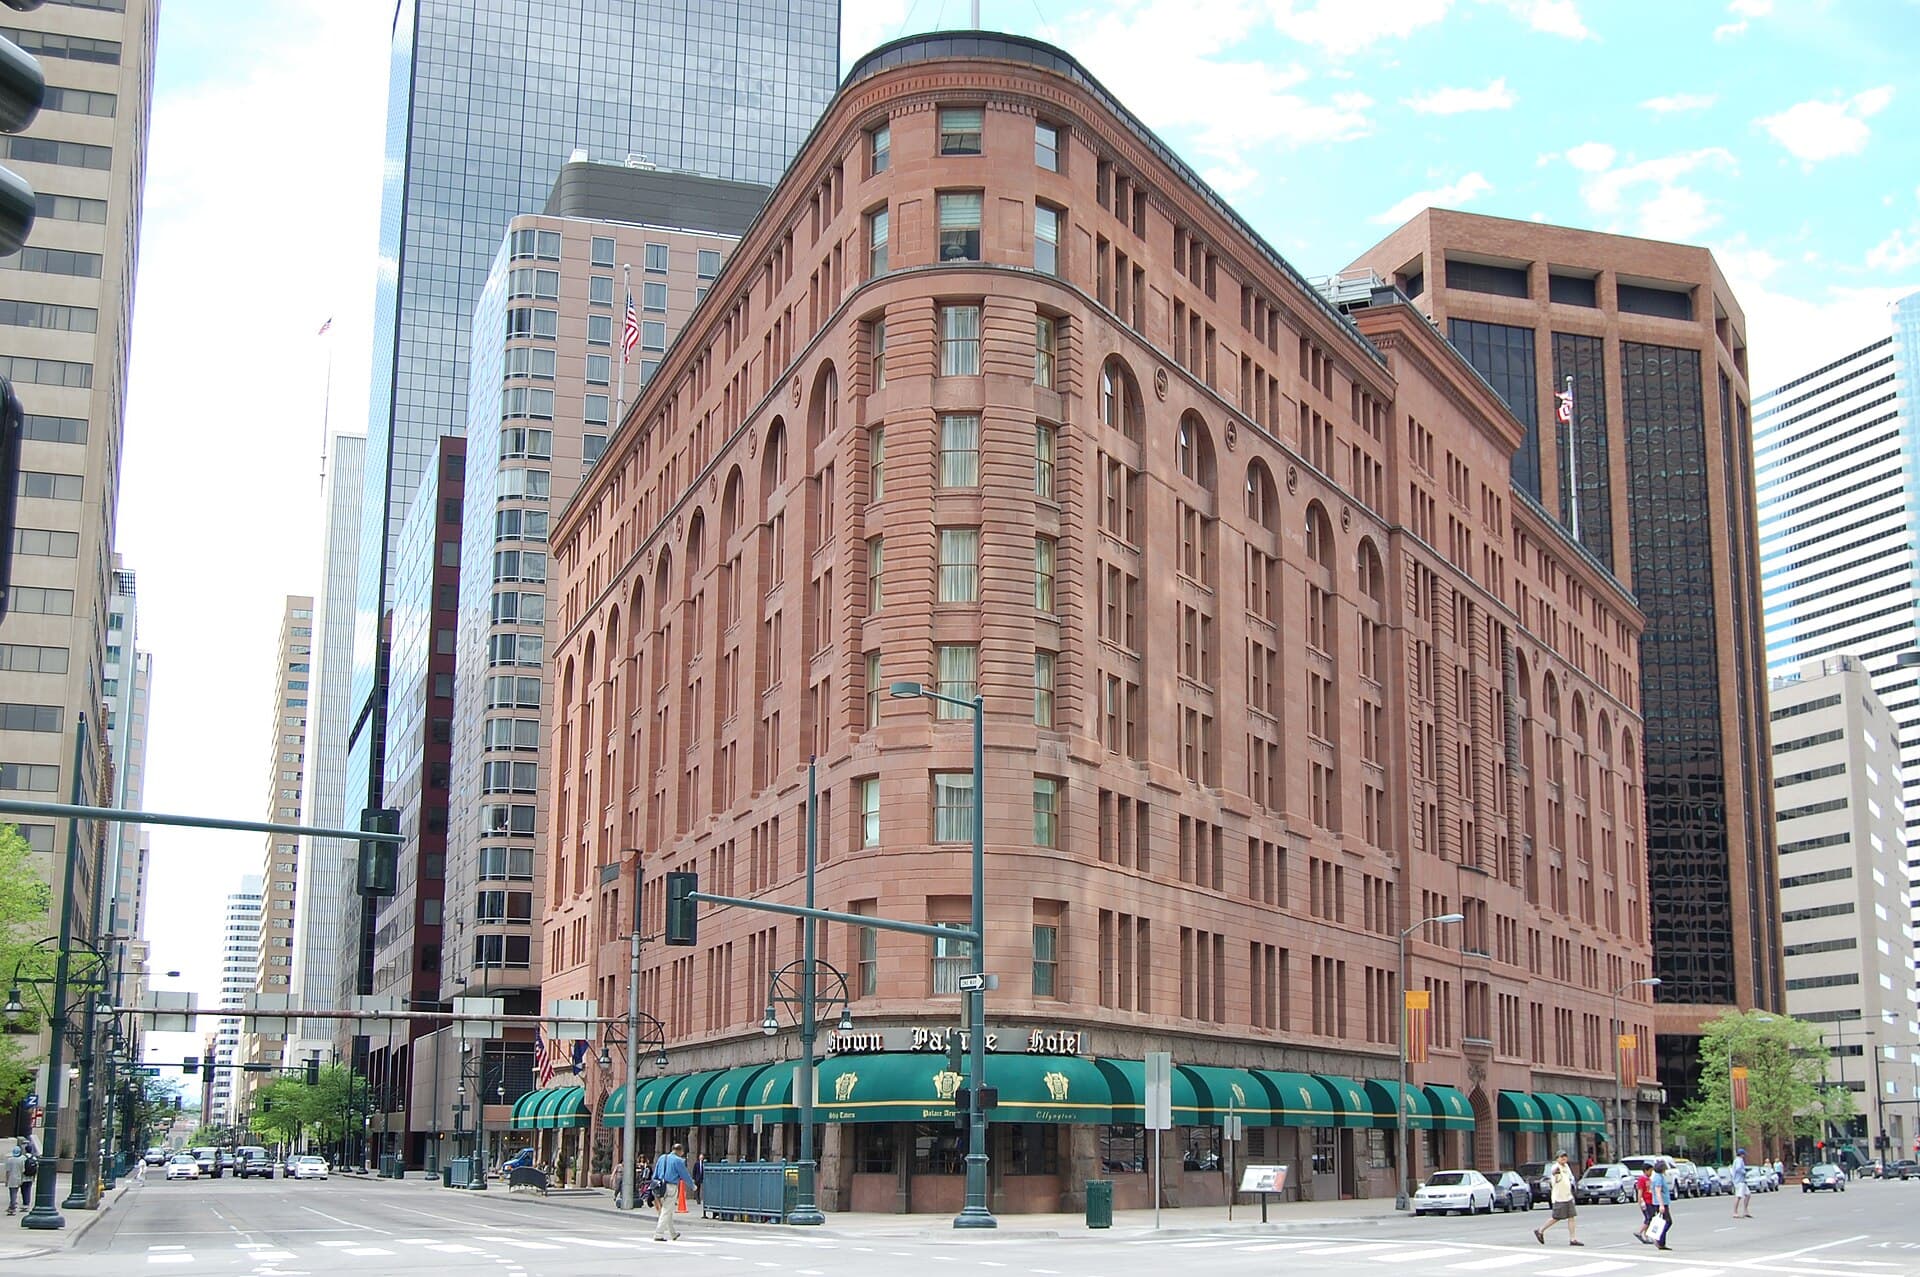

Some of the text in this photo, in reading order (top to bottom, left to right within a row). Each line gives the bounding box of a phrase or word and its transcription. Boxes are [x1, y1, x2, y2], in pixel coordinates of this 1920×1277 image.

[827, 1026, 1082, 1054] Brown Palae Hotel
